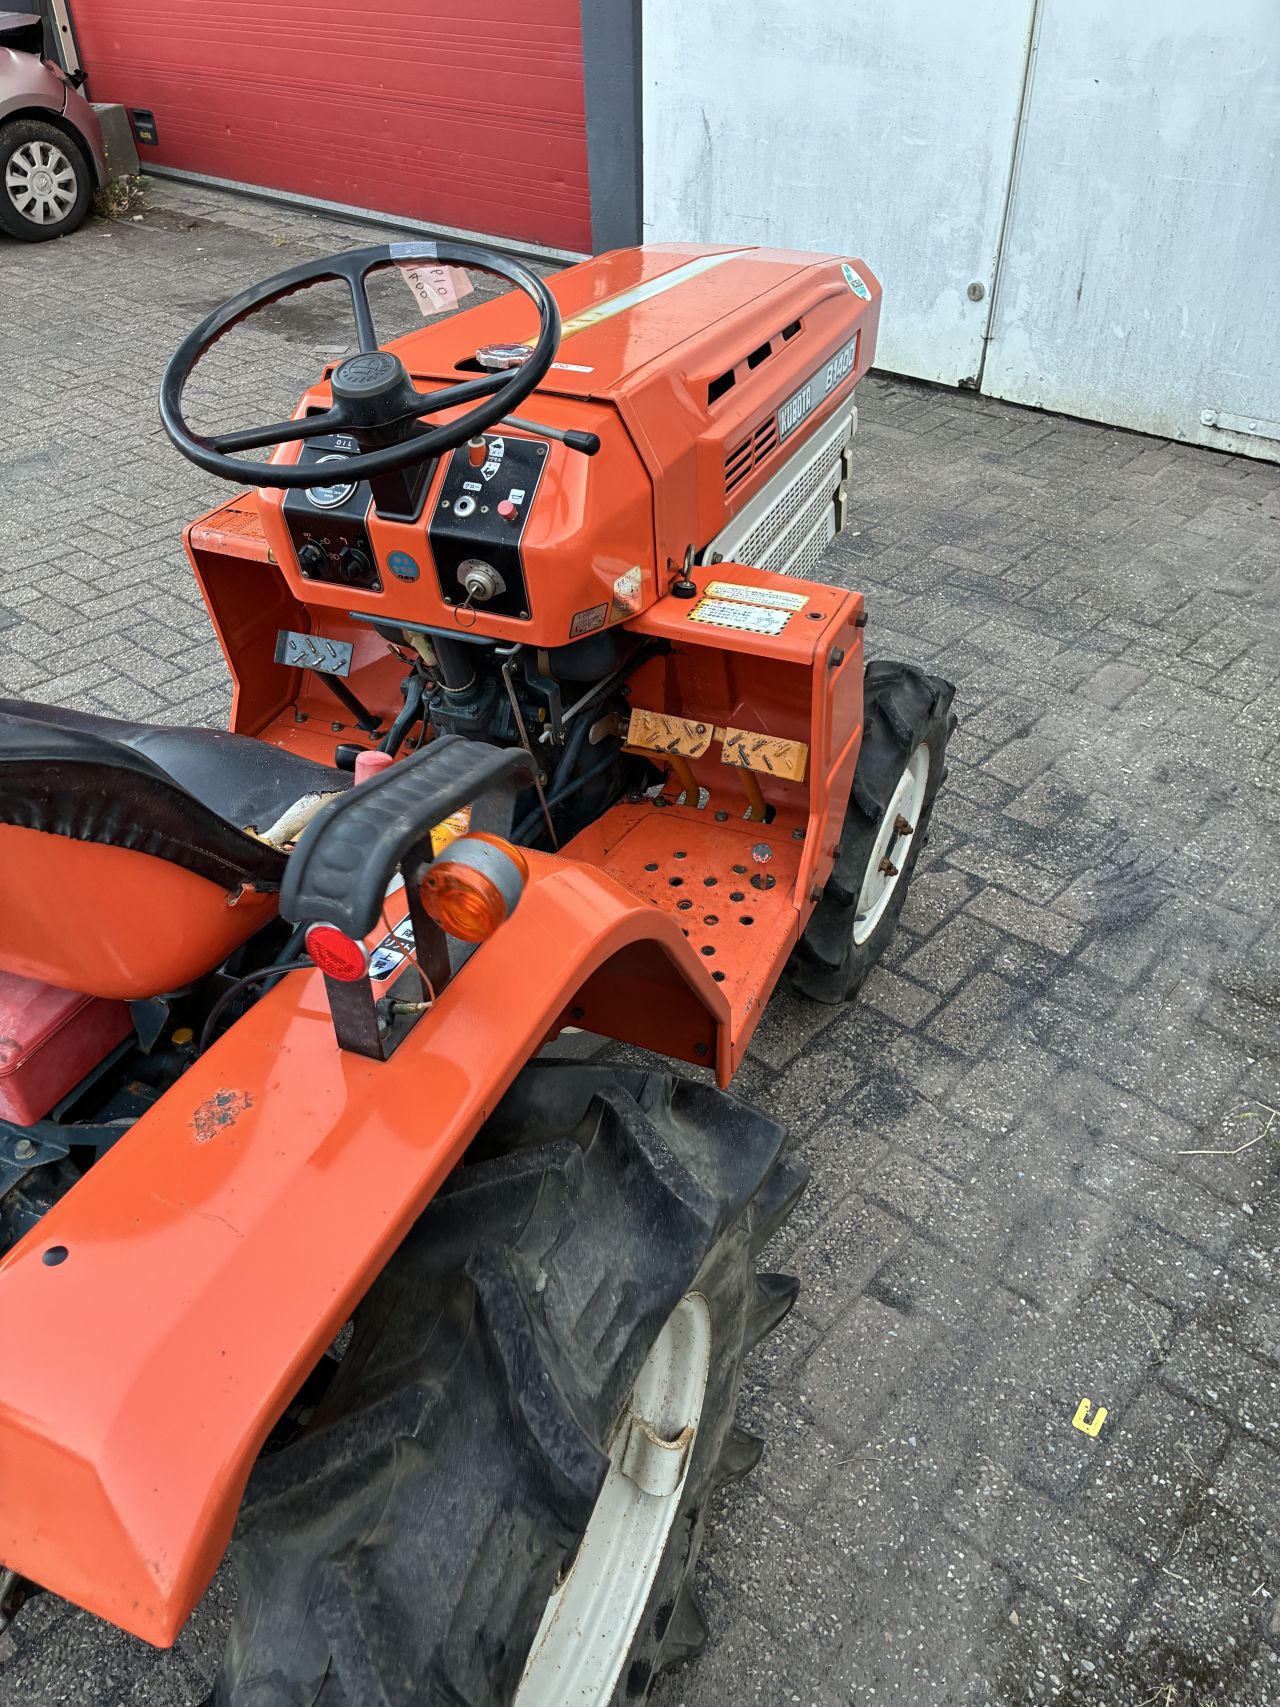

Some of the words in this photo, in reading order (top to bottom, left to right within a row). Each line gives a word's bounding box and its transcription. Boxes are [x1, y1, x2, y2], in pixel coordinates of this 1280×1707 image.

[781, 385, 812, 437] KUBOTA
[825, 342, 856, 392] B1400
[336, 439, 352, 447] OIL
